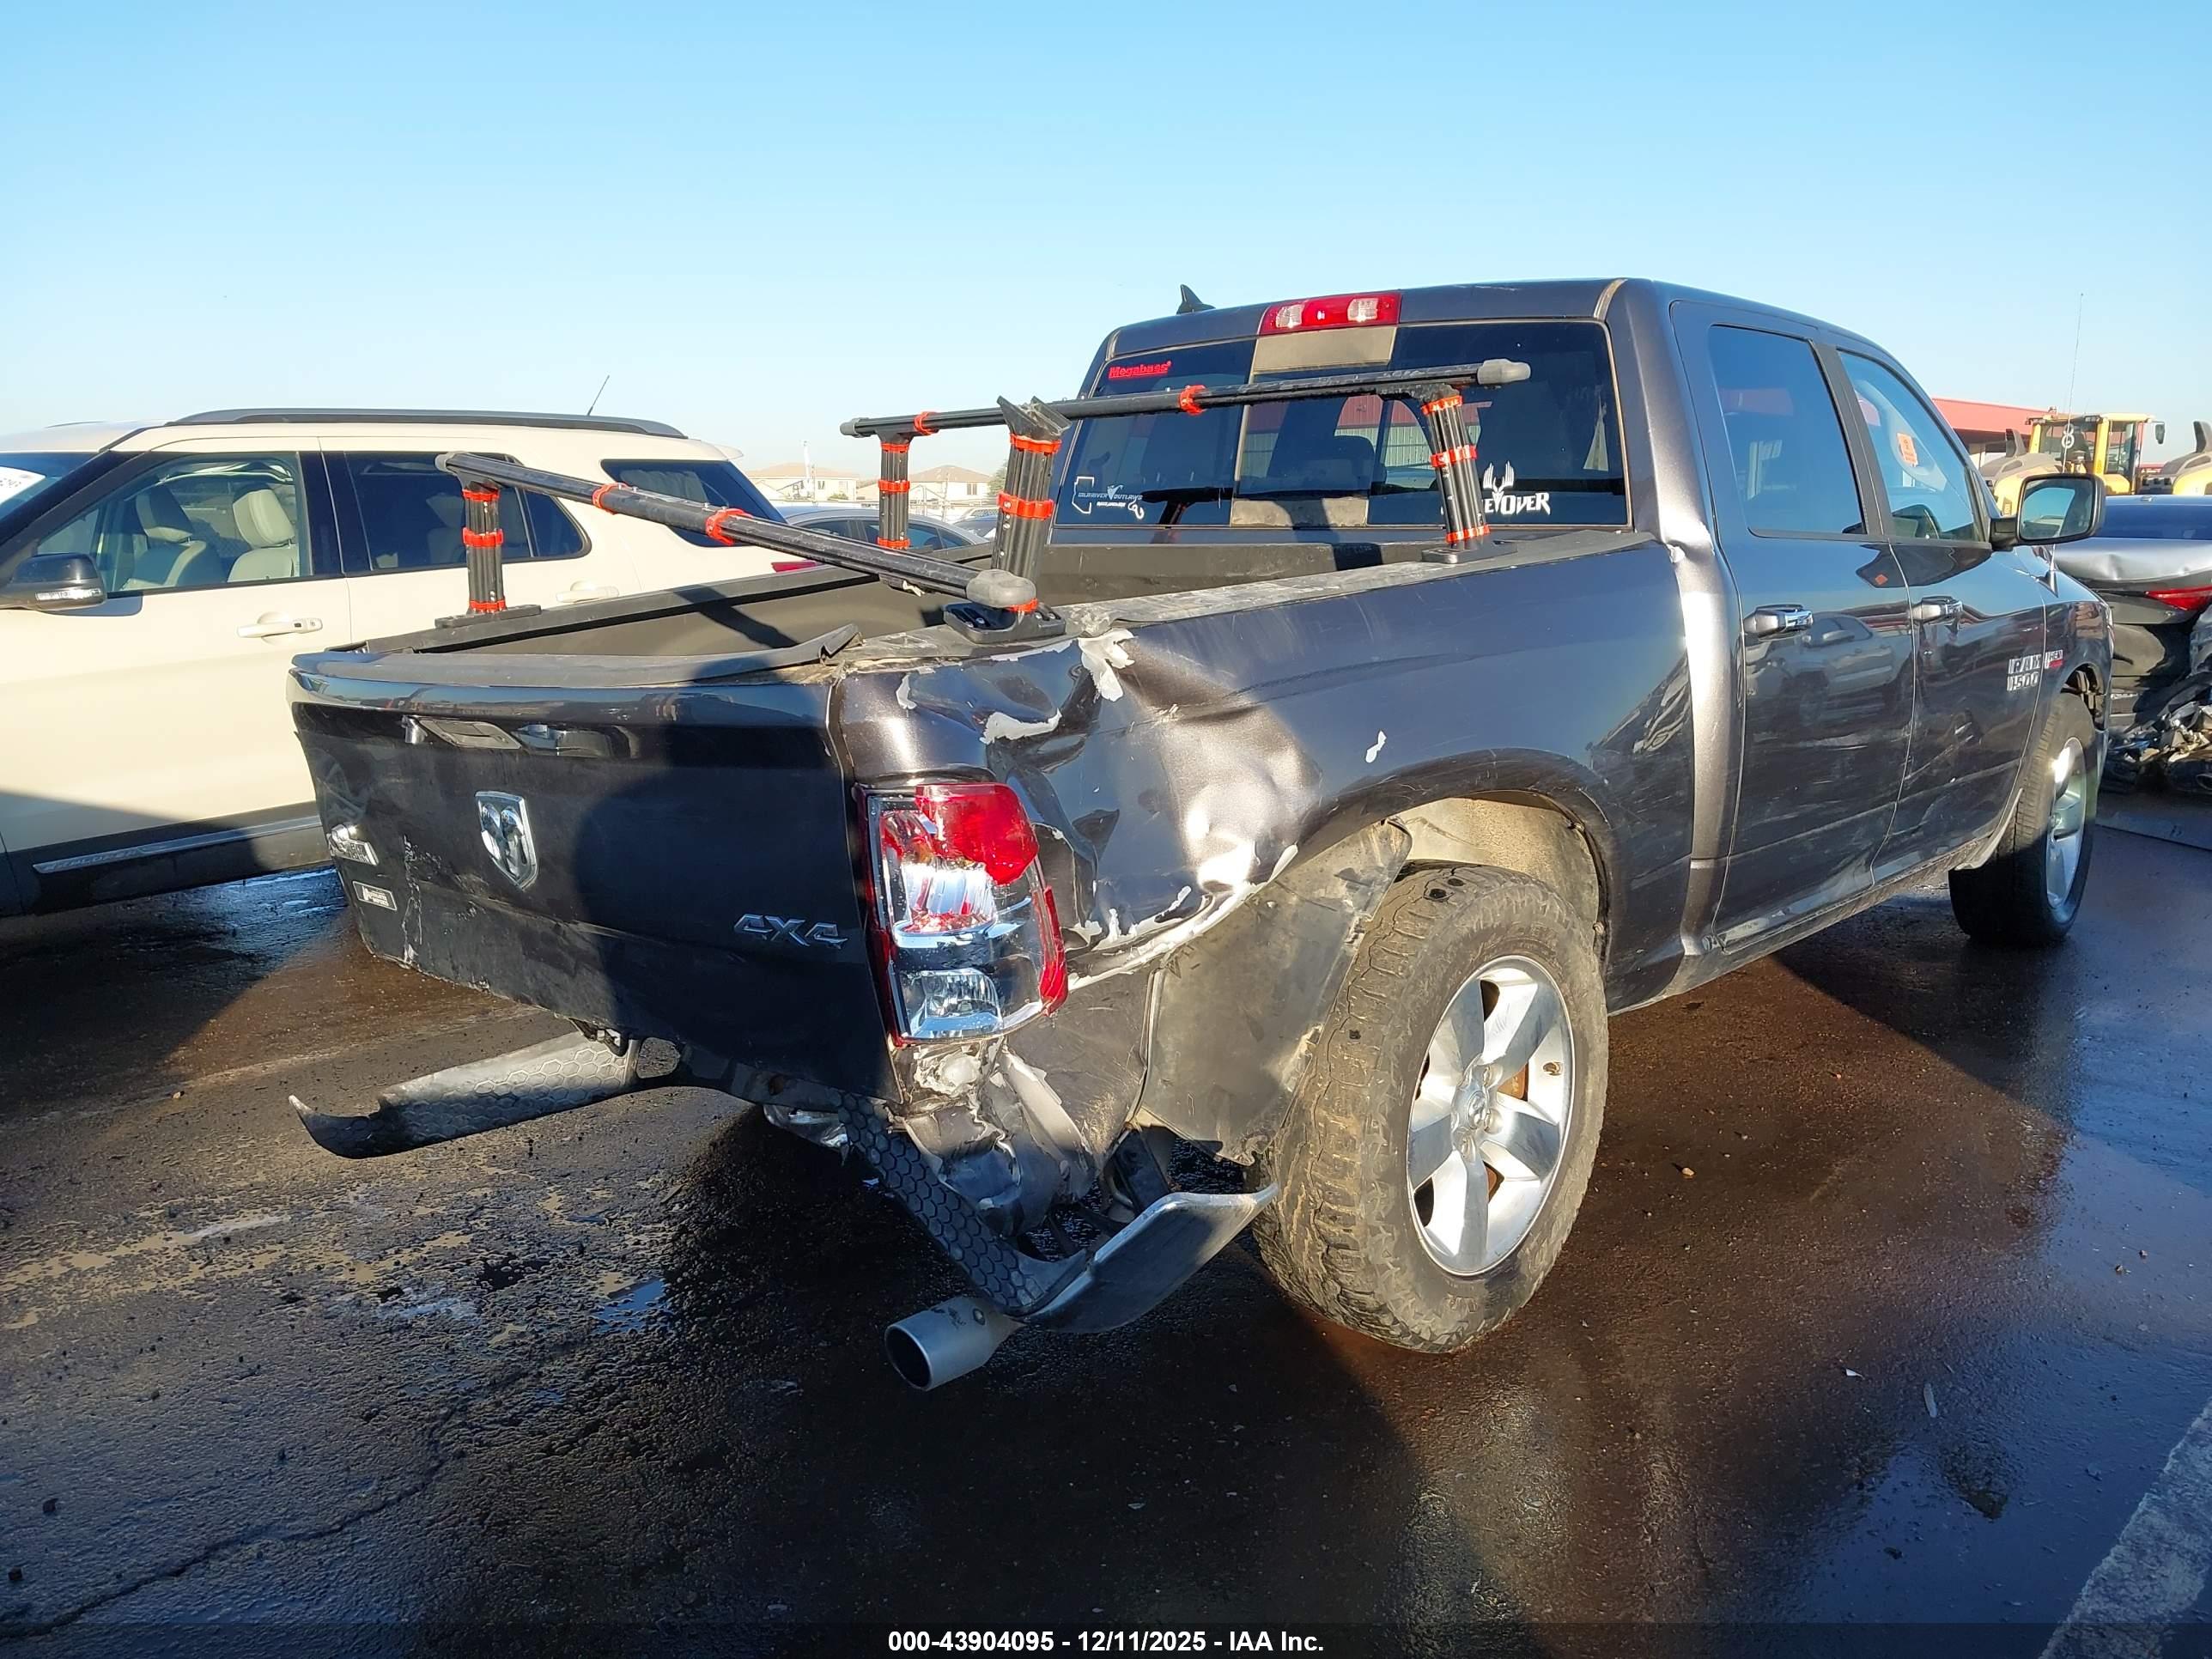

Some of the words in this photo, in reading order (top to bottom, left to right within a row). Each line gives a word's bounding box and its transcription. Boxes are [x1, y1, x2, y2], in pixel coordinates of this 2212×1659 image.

[1109, 363, 1170, 378] Megabass
[2008, 654, 2042, 675] RAM
[2007, 672, 2040, 691] 1500
